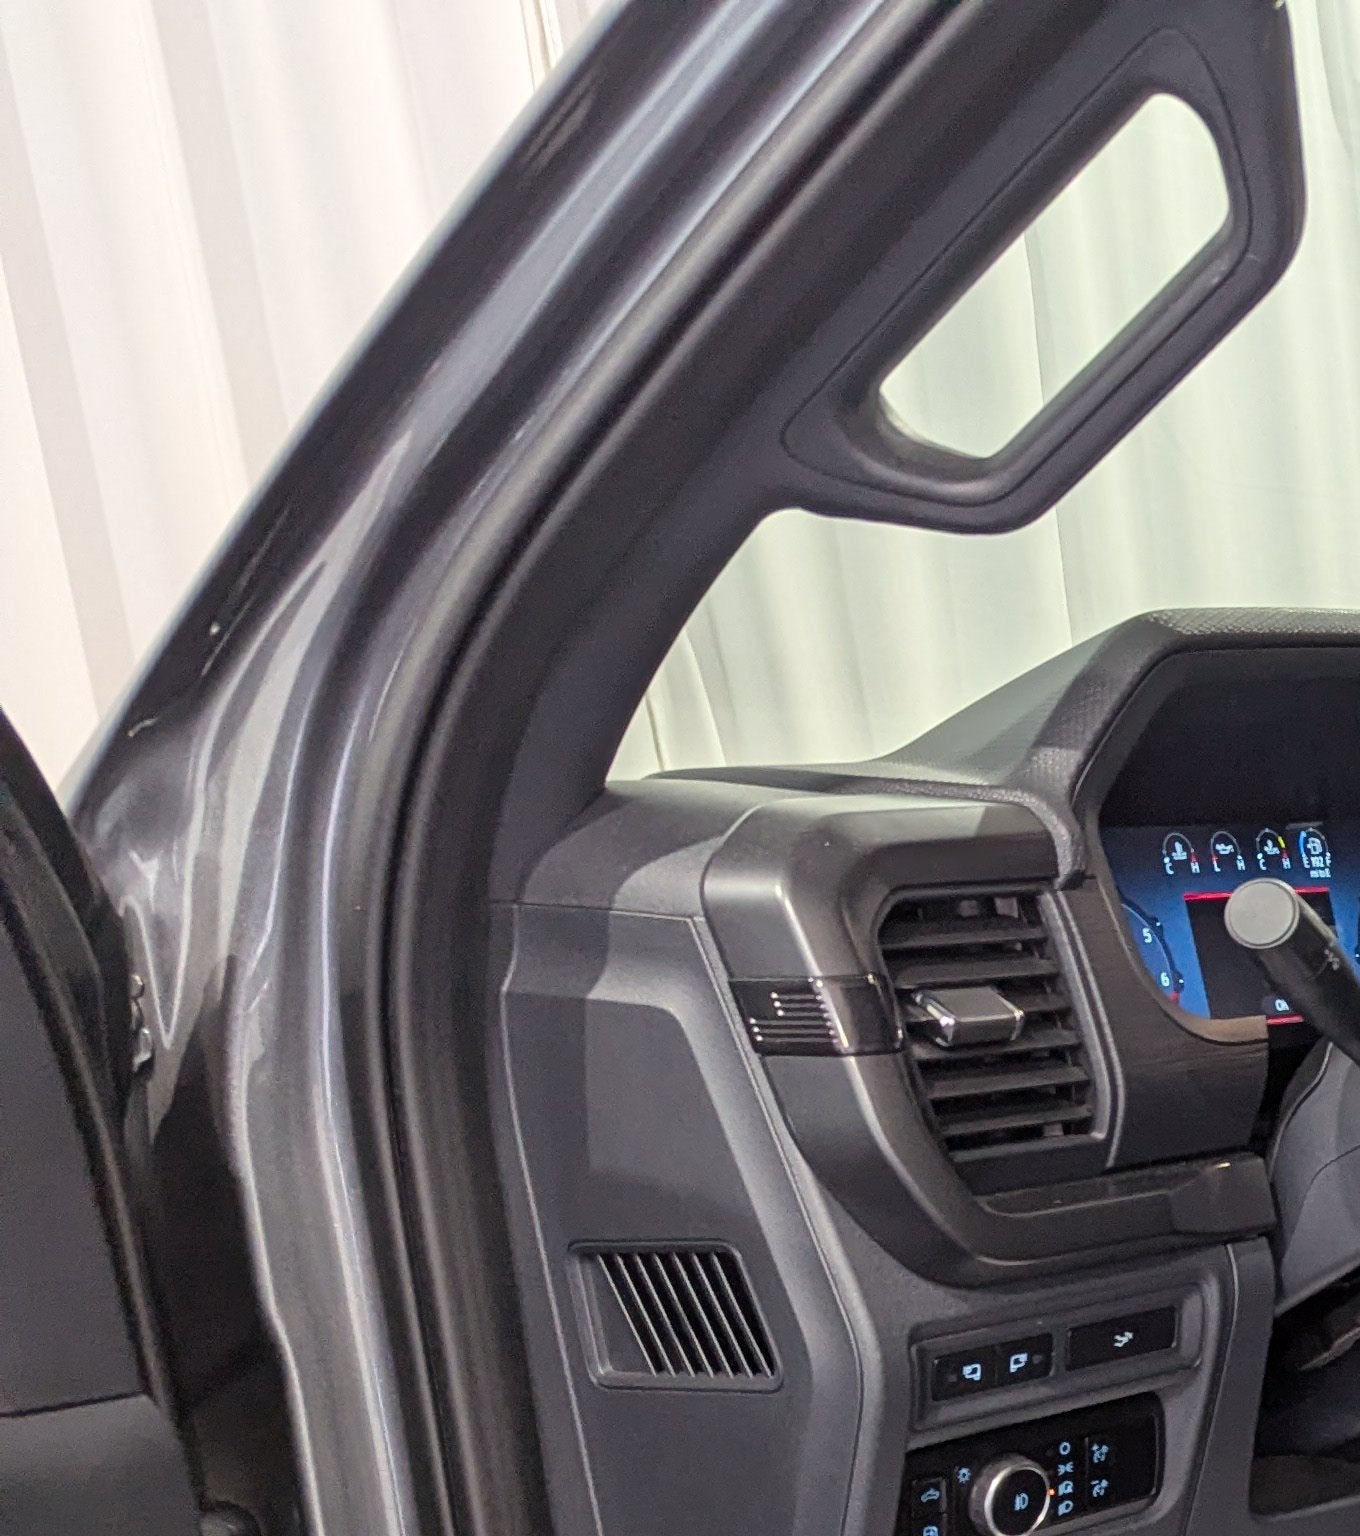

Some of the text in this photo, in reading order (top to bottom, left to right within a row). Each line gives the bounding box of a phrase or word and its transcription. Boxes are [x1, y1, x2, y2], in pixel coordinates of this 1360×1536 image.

[1165, 861, 1201, 875] C H
[1236, 858, 1246, 871] H
[1258, 857, 1292, 871] C H
[1142, 927, 1153, 943] 5
[1160, 972, 1170, 987] 6
